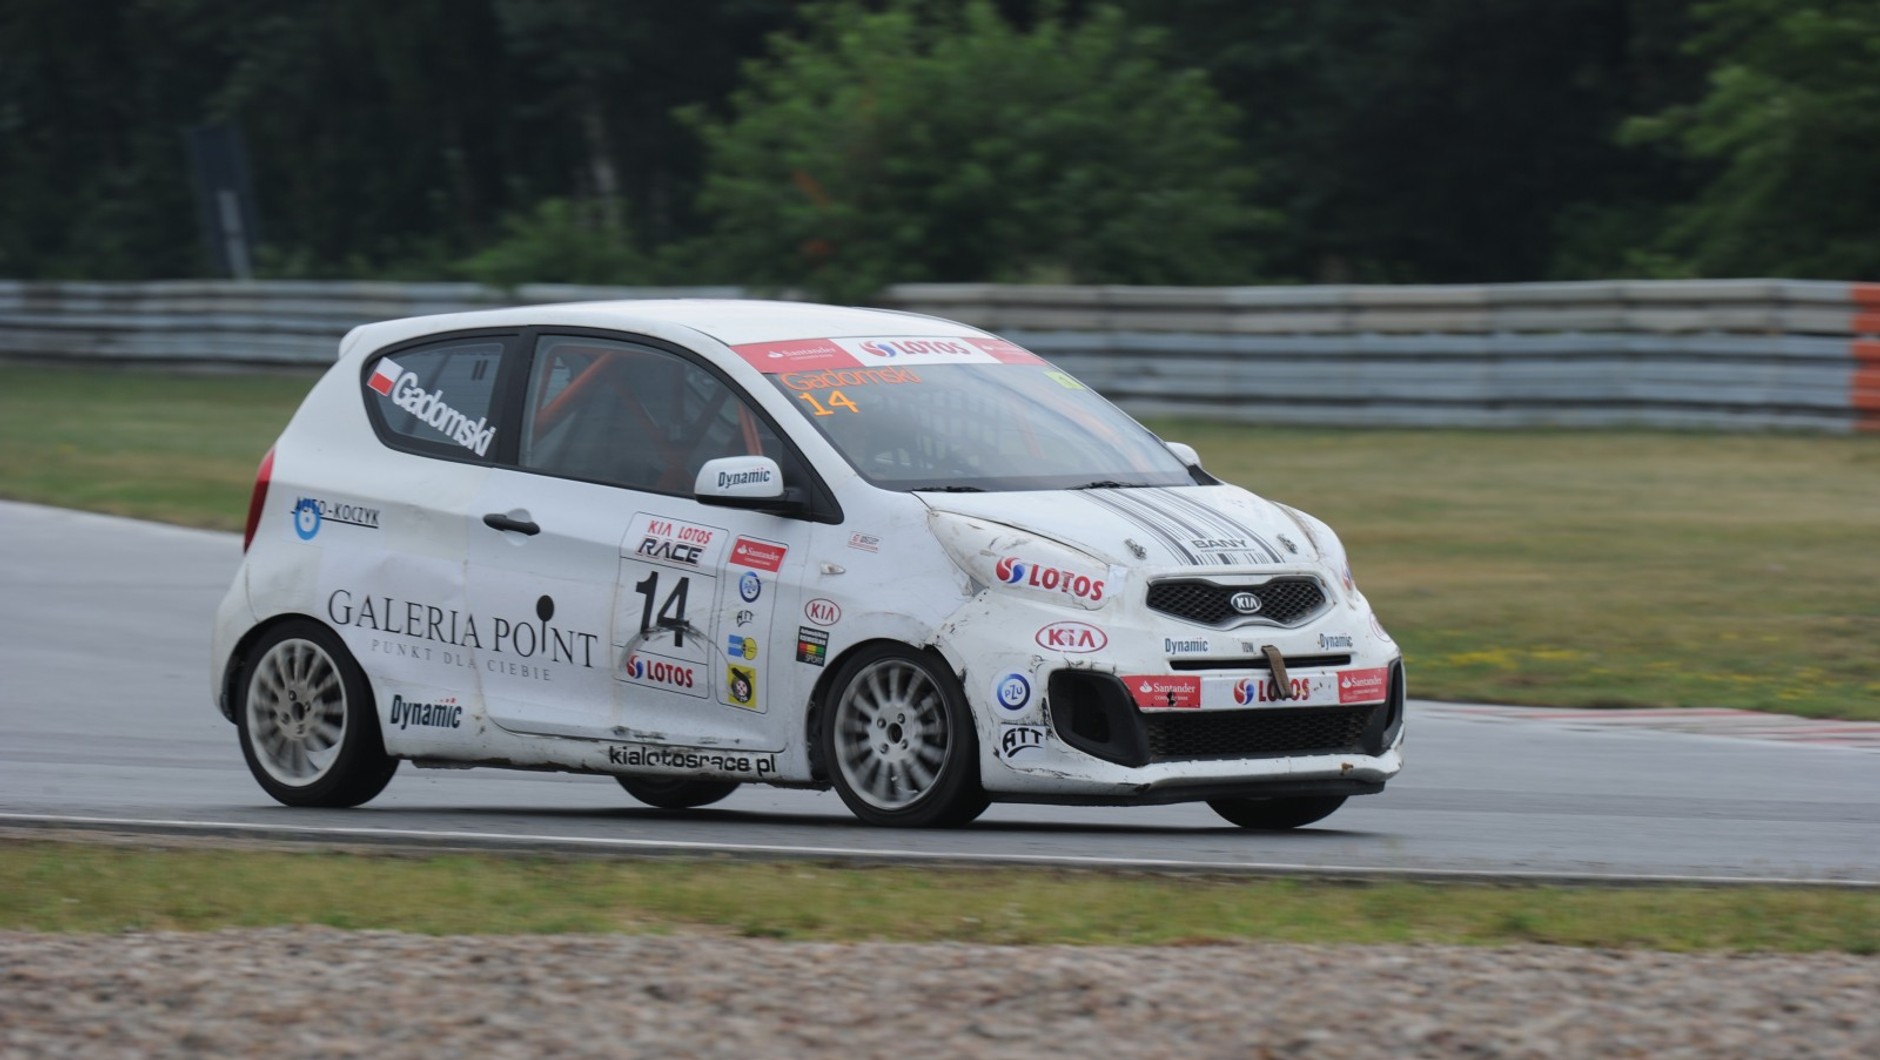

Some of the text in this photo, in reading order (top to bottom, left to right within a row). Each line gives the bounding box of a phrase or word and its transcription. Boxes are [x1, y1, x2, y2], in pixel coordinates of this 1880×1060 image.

[895, 340, 969, 354] LOTOS
[780, 366, 922, 390] Gadomski
[391, 371, 496, 457] Gadomski
[799, 390, 860, 416] 14
[717, 467, 771, 489] Dynamic
[647, 520, 713, 545] KIA LOTOS
[636, 538, 703, 564] RACE
[1028, 562, 1105, 601] LOTOS
[635, 571, 690, 647] 14
[811, 602, 834, 622] KIA
[1236, 596, 1260, 610] KIA
[328, 589, 598, 668] GALERIA POINT
[1047, 629, 1096, 648] KIA
[1164, 637, 1208, 654] Dynamic
[1319, 633, 1353, 650] Dynamic
[371, 639, 551, 681] PUNKT DLA CIEBIE
[647, 660, 693, 688] LOTOS
[1005, 684, 1025, 700] PZU
[1153, 675, 1383, 702] Santander LOOS Santander
[390, 695, 463, 730] Dynamic
[1002, 727, 1045, 758] ATT
